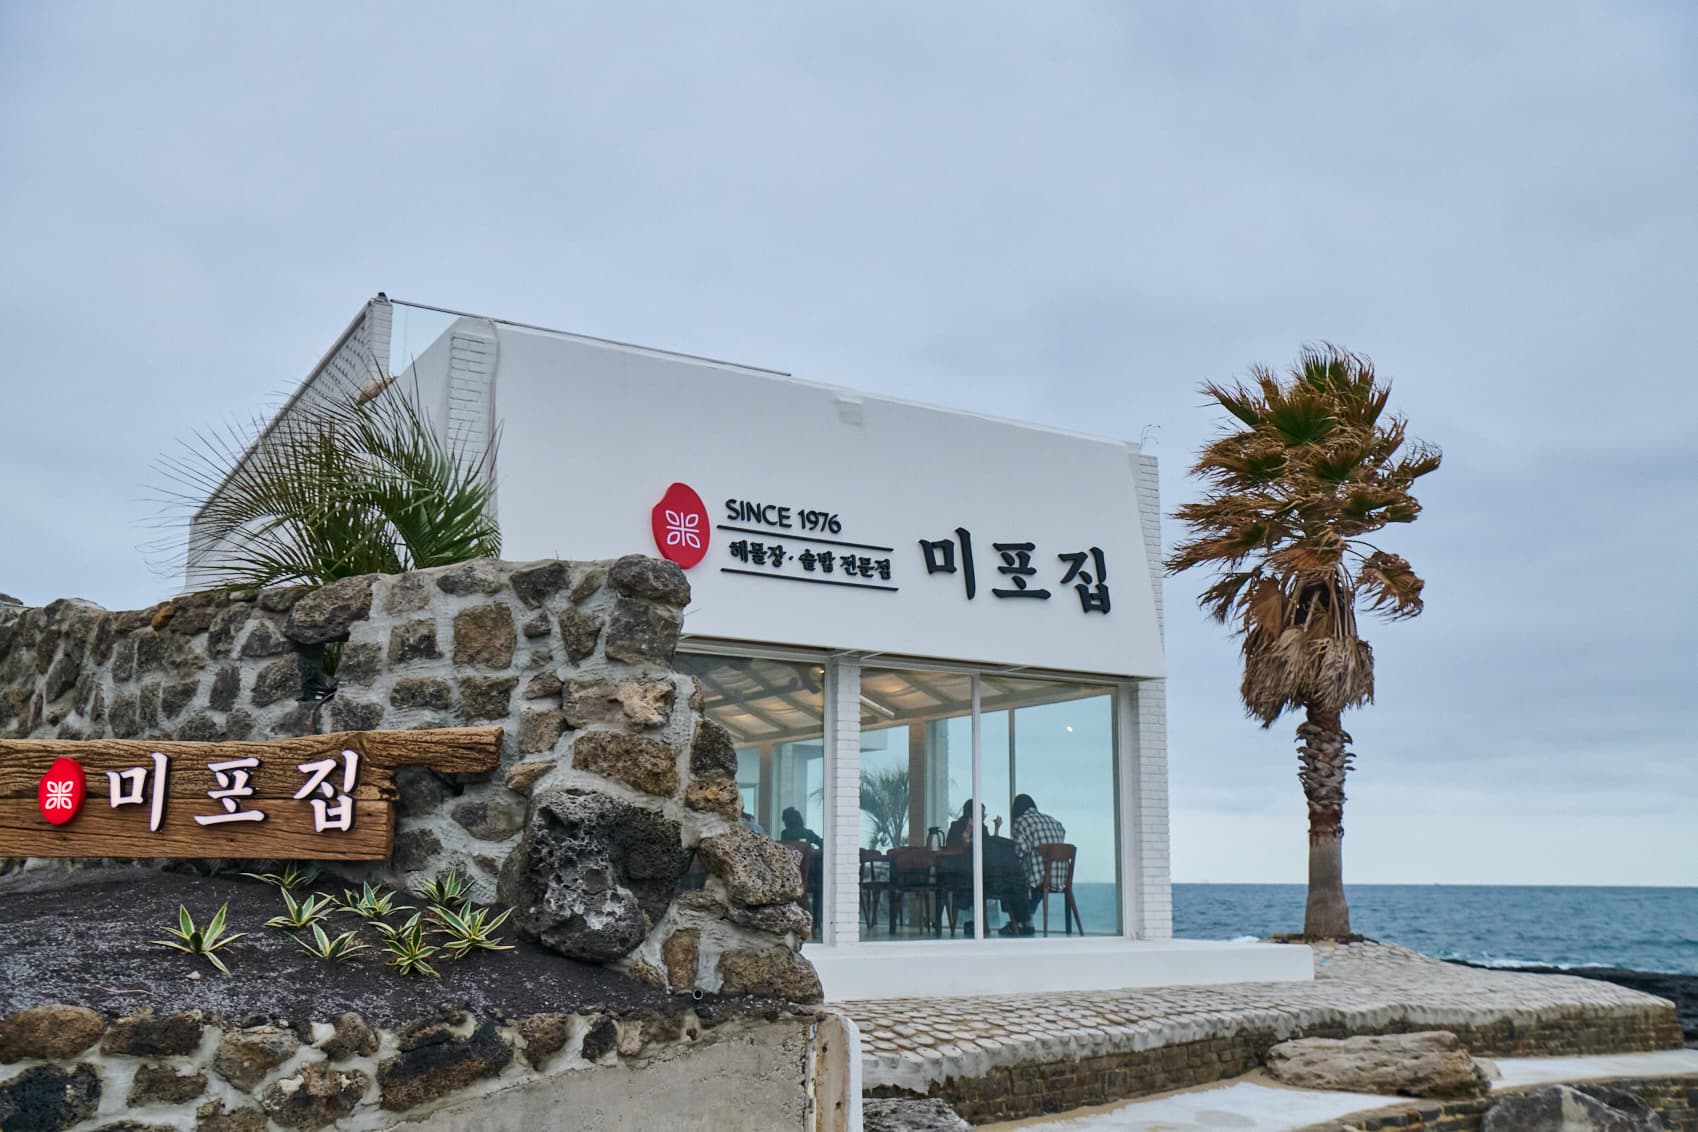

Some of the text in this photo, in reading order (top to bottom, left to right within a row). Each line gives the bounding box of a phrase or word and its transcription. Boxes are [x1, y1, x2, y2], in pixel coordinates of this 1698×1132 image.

[725, 498, 842, 535] SINCE 1976
[839, 554, 892, 581] 전문점
